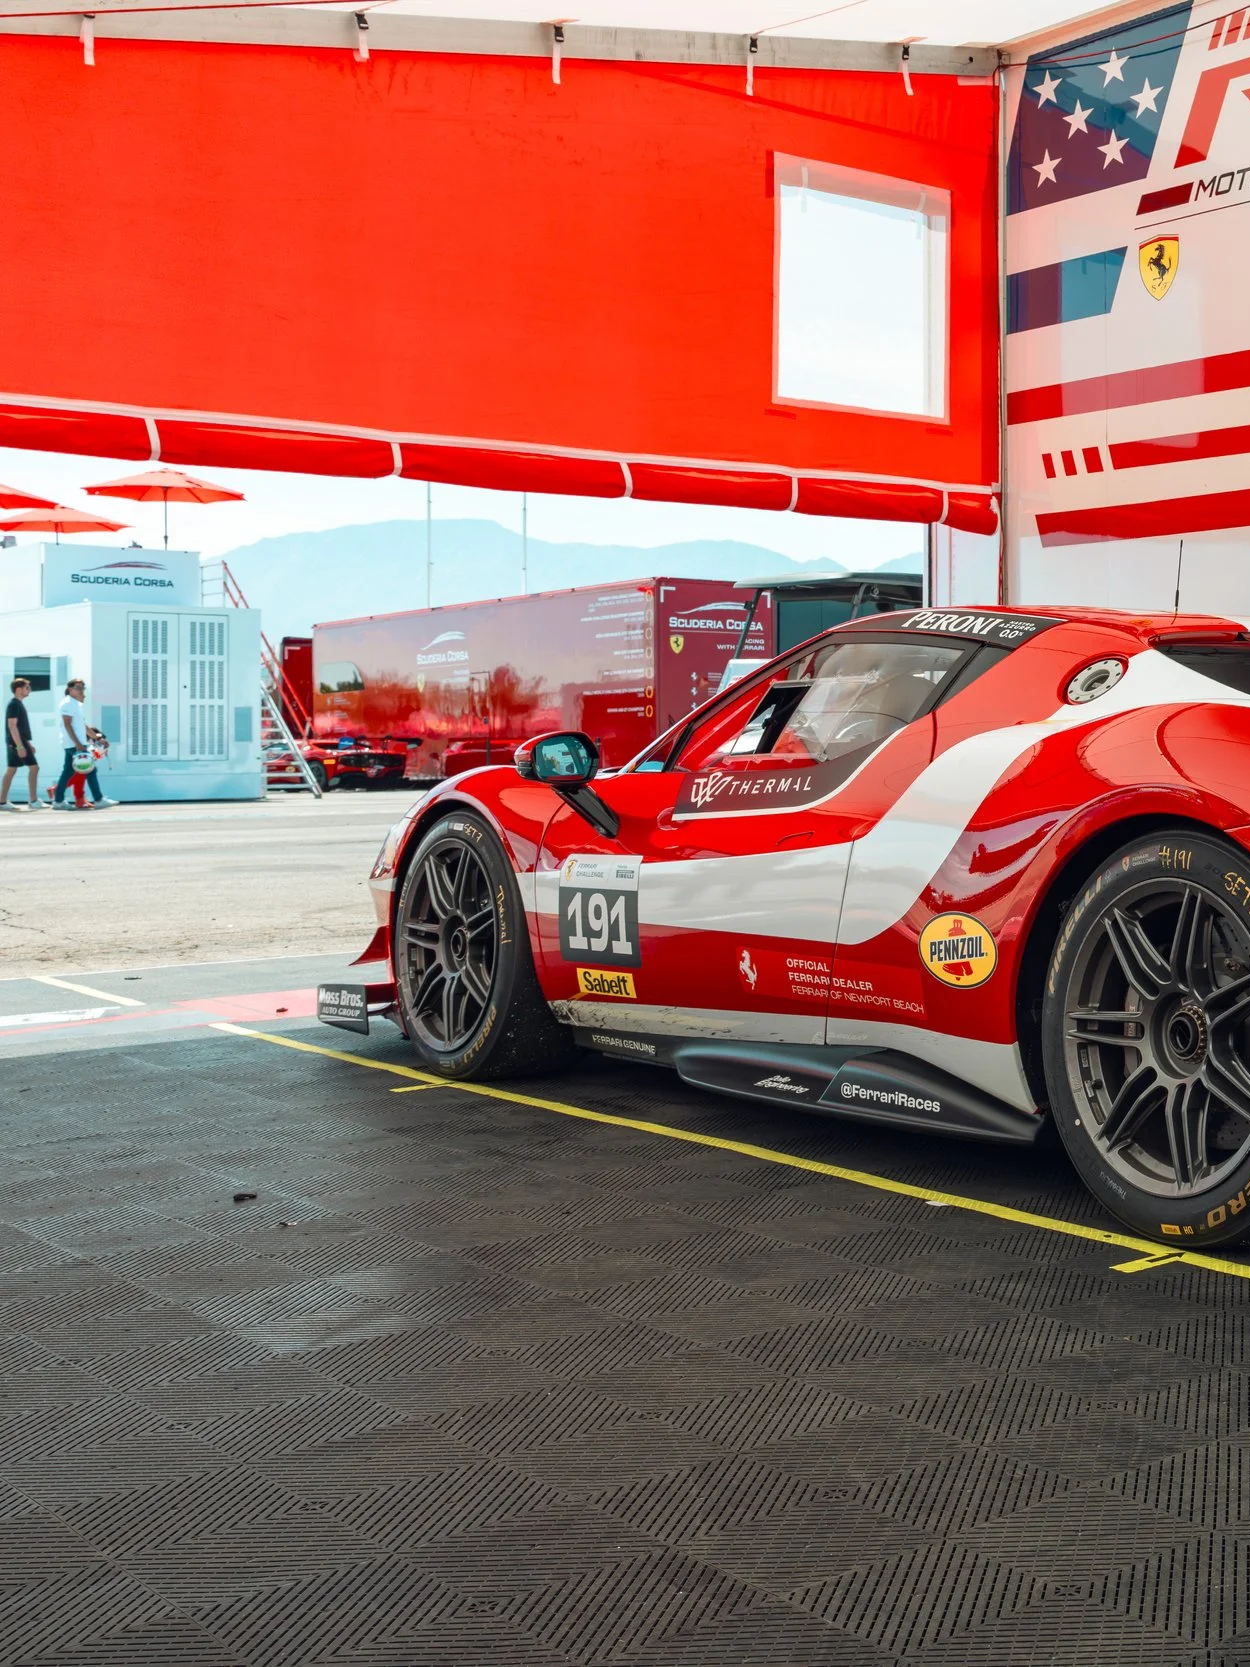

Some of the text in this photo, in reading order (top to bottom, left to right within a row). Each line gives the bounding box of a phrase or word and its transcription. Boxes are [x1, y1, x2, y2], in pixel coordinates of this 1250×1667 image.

[71, 574, 174, 588] SCUDERIA CORSA
[669, 616, 724, 629] SCUDERIA
[901, 612, 1003, 635] PERONI
[729, 776, 812, 795] THERMAL
[1158, 845, 1192, 870] #191
[616, 869, 634, 879] PIRELLI
[567, 891, 633, 955] 191
[1048, 875, 1102, 994] PIRELLI
[929, 936, 985, 962] PENNZOIL
[786, 958, 830, 973] OFFICIAL
[583, 970, 630, 996] Sabelt
[788, 971, 873, 991] FERRARI DEALER
[319, 988, 364, 1007] Moss Bros.
[791, 984, 925, 1014] FERRARI OF NEWPORT BEACH
[338, 1007, 361, 1017] GROUP
[592, 1034, 656, 1055] FERRARI GENUINE
[841, 1082, 941, 1113] @FerrariRaces
